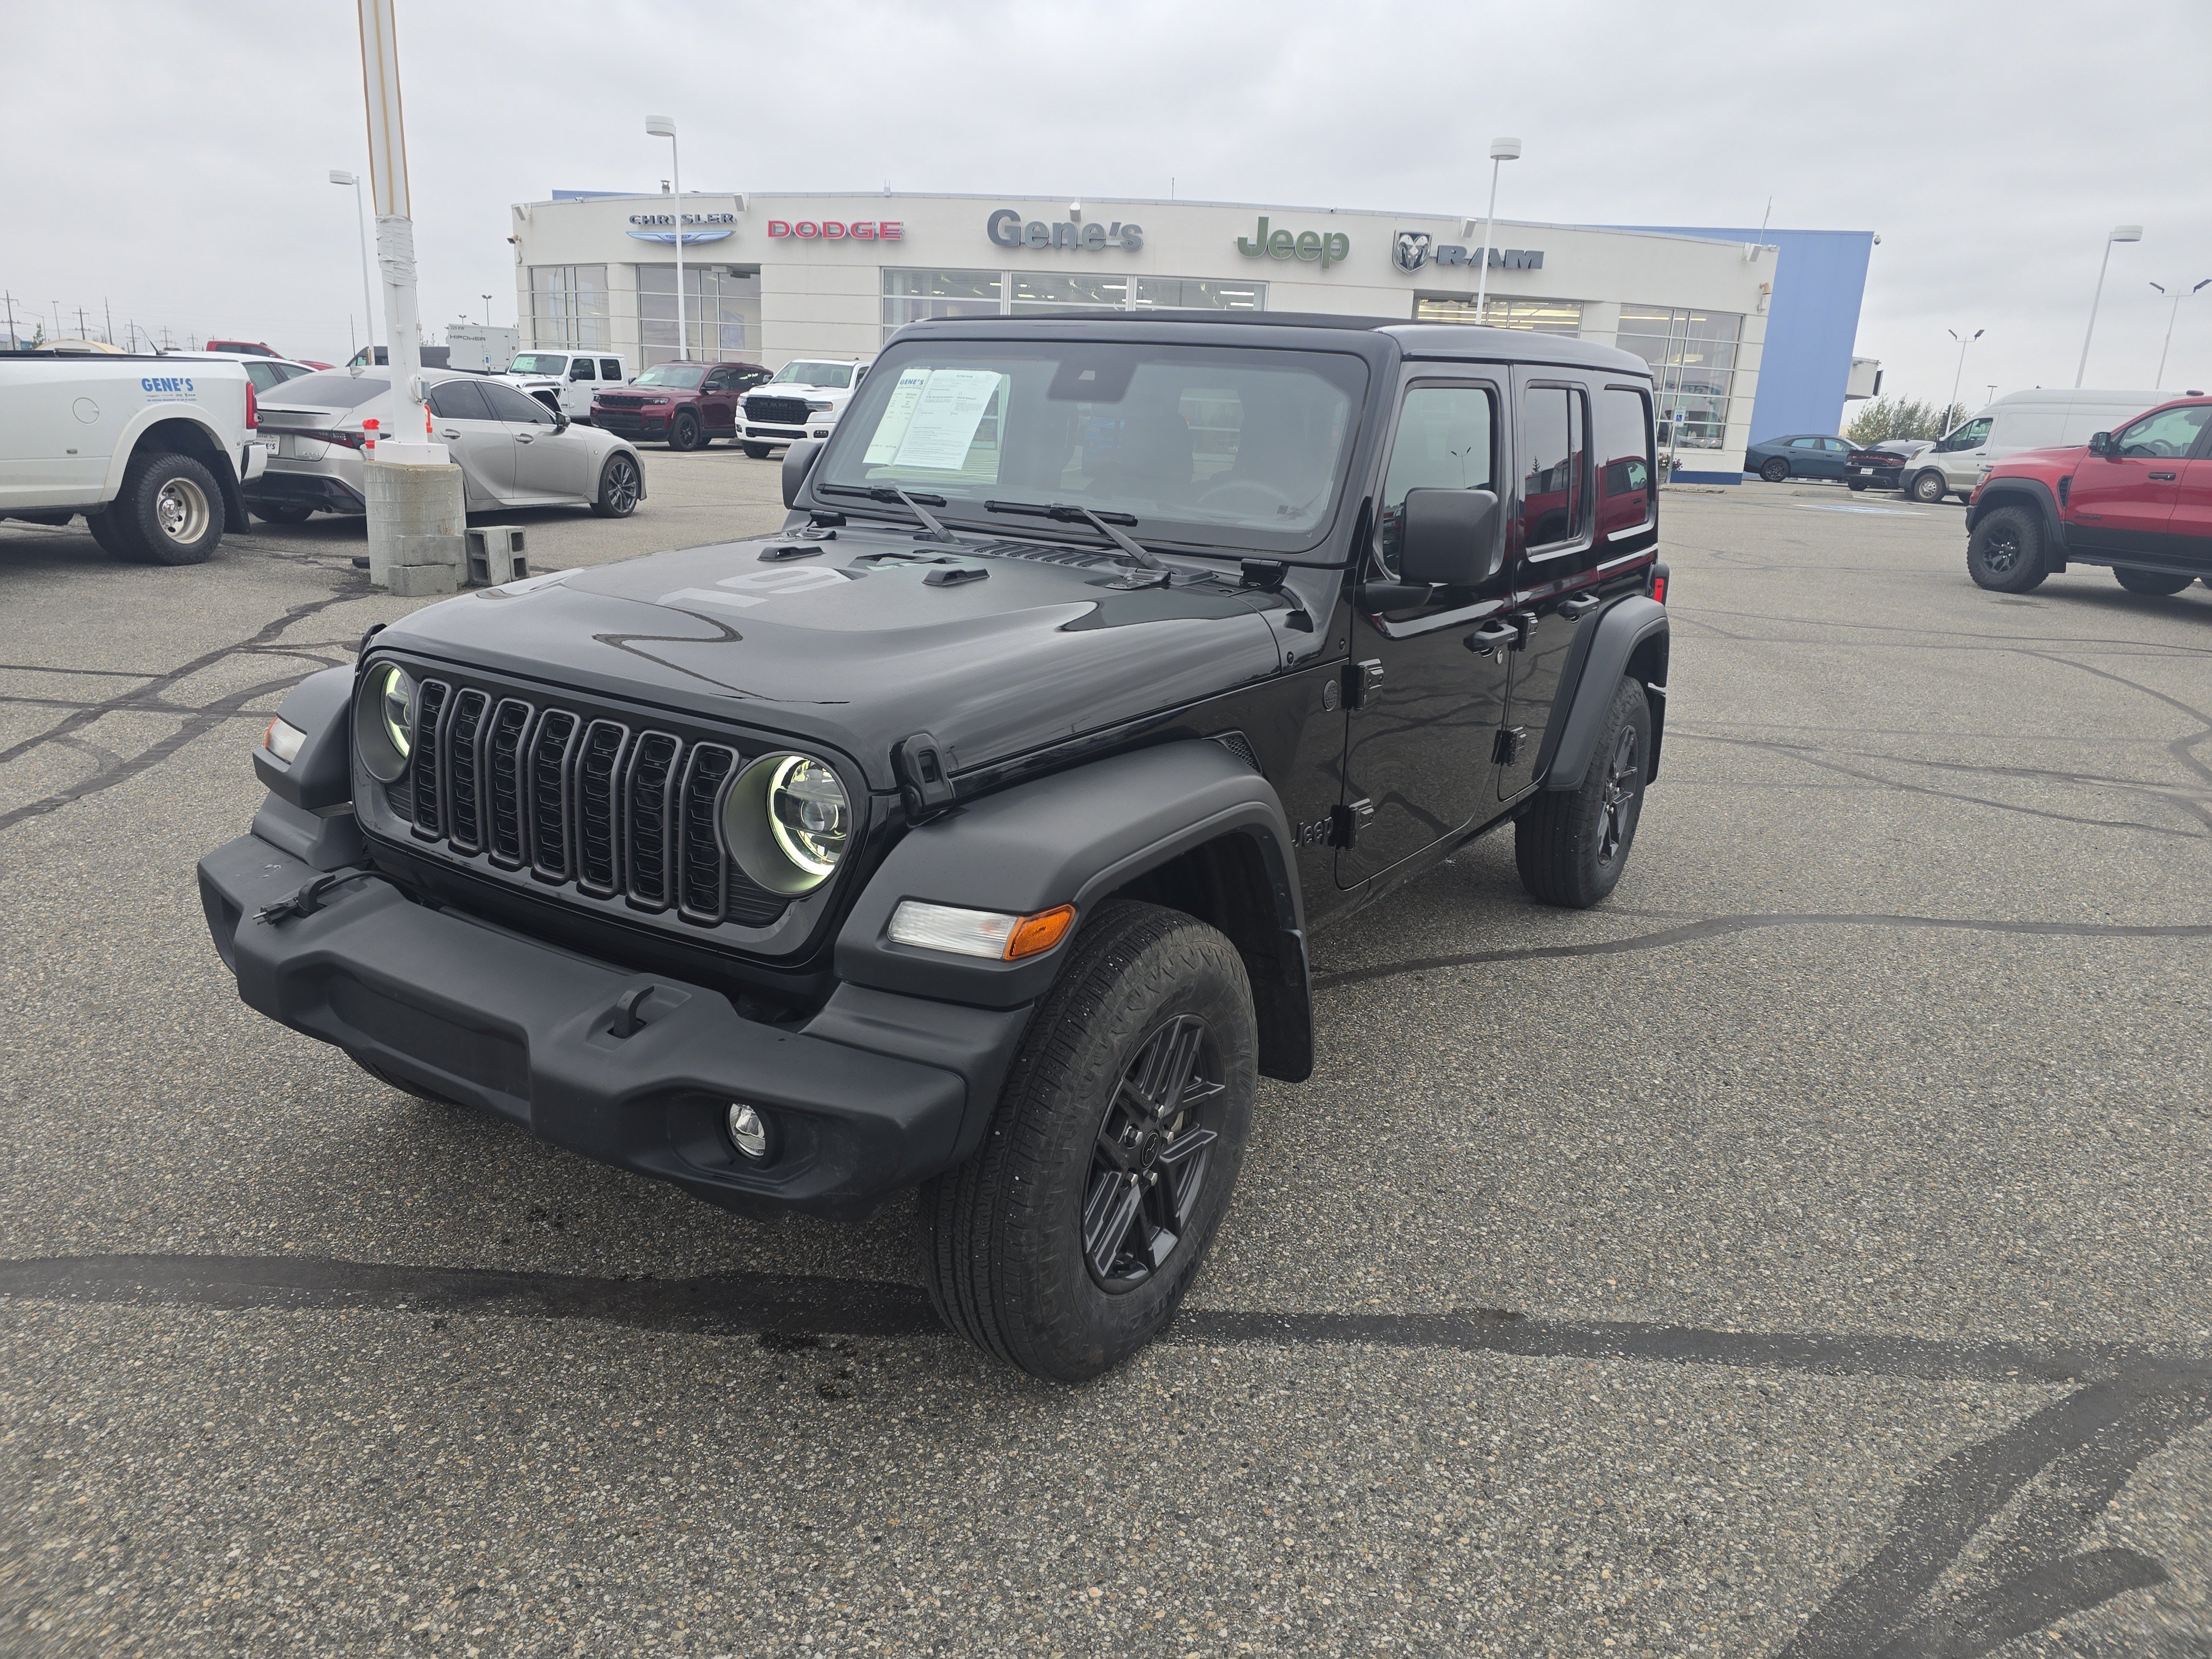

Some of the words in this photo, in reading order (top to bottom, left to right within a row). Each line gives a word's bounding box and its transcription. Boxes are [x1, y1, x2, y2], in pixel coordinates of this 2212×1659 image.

[629, 213, 735, 225] CHRYSLER
[768, 220, 903, 240] DODGE
[987, 209, 1143, 252] Gene's
[1237, 216, 1350, 269] Jeep
[1437, 245, 1545, 270] RAM
[141, 377, 194, 392] GENE'S
[1291, 816, 1334, 847] Jeep
